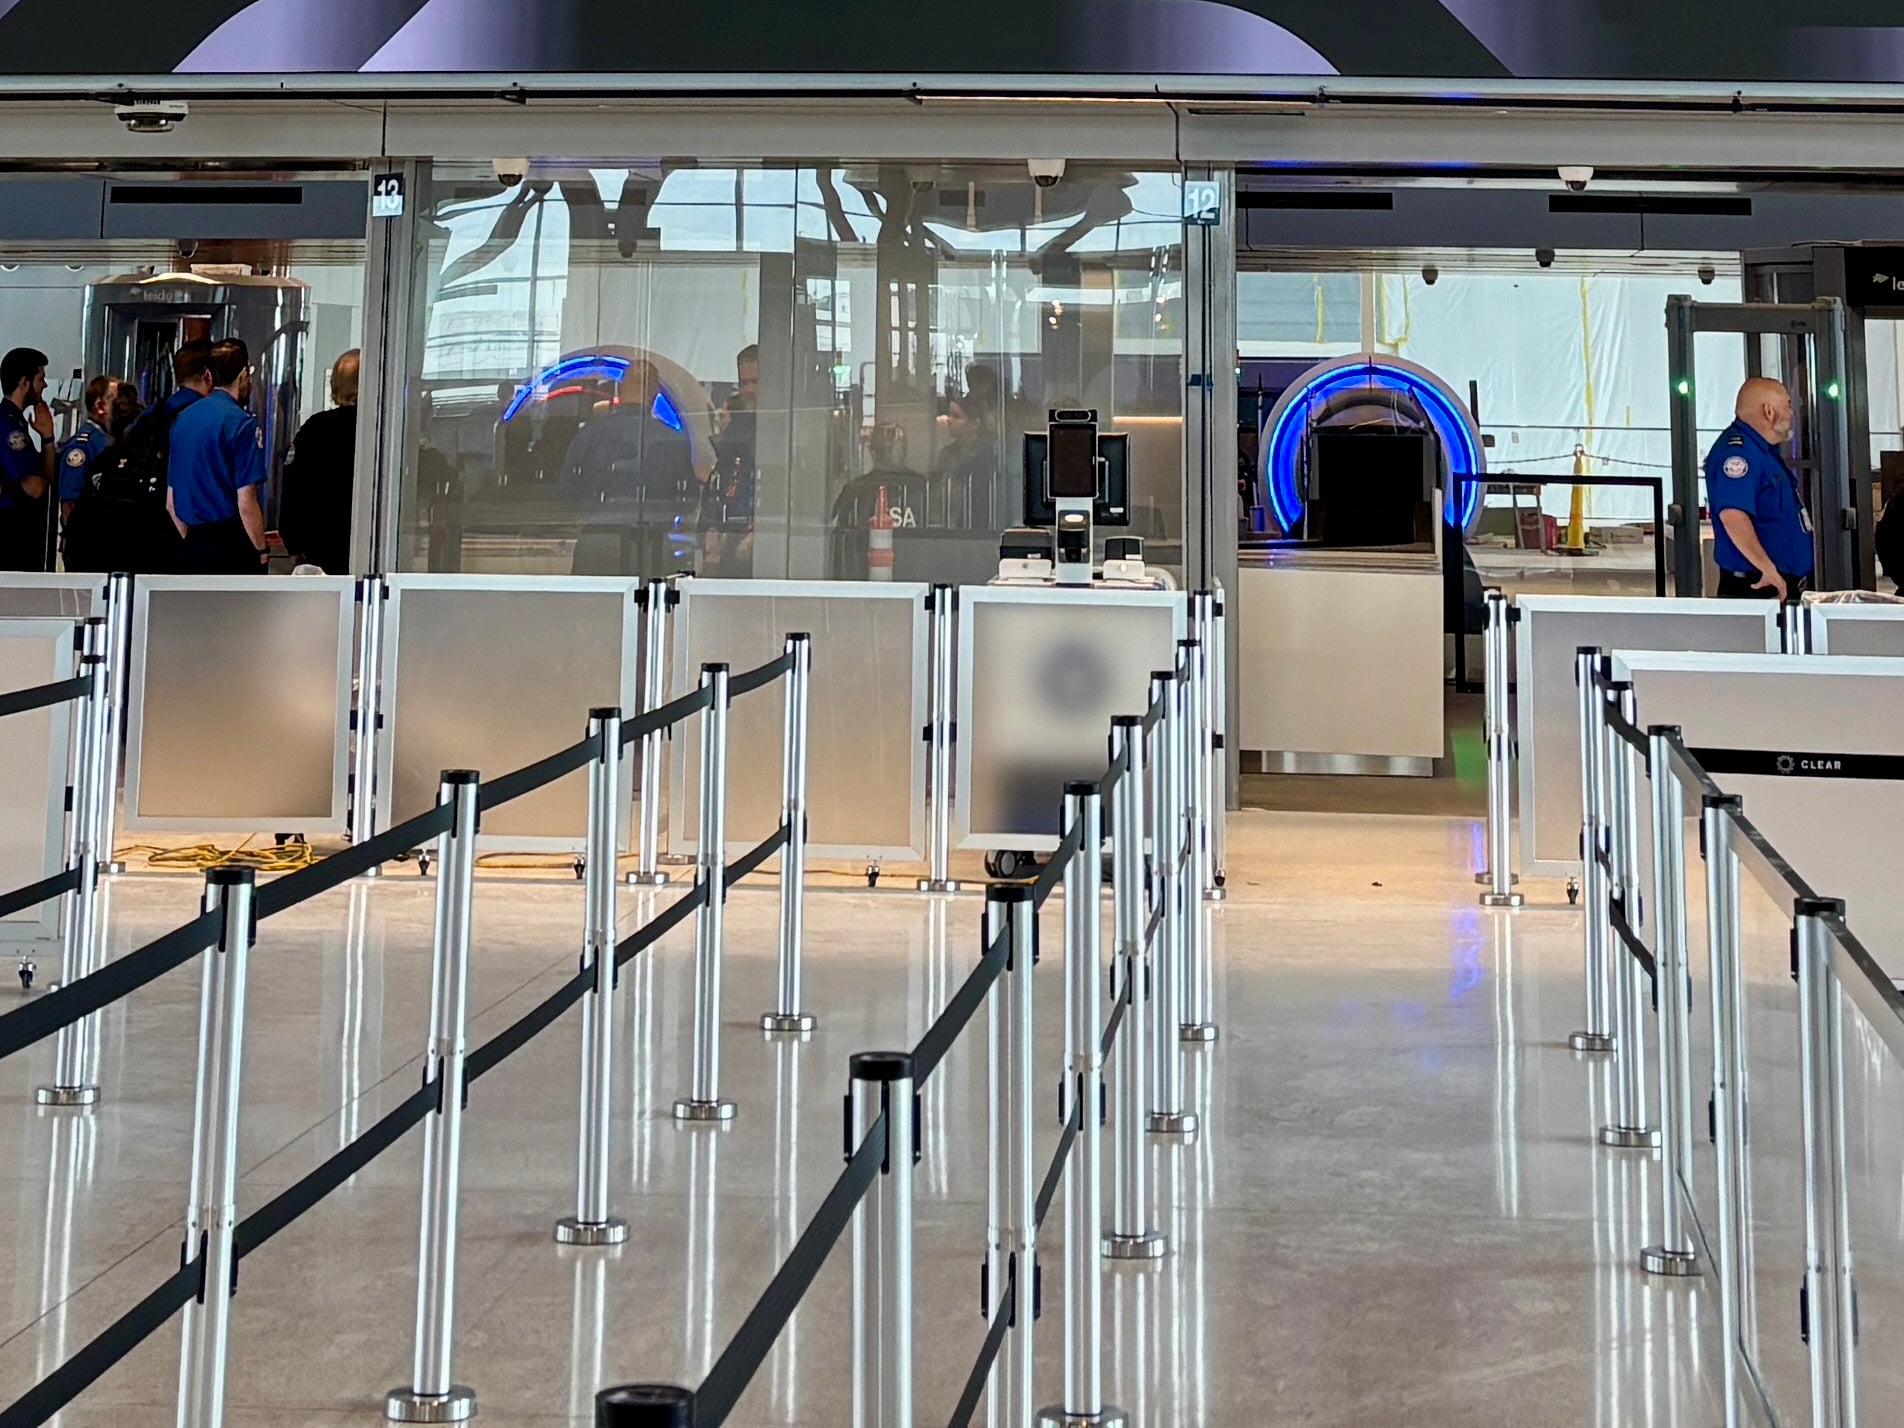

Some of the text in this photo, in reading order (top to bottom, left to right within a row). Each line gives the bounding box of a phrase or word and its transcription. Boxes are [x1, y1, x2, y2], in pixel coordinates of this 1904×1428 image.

[377, 179, 399, 210] 13
[1188, 188, 1216, 219] 12
[889, 506, 916, 528] SA
[1800, 759, 1841, 770] CLEAR
